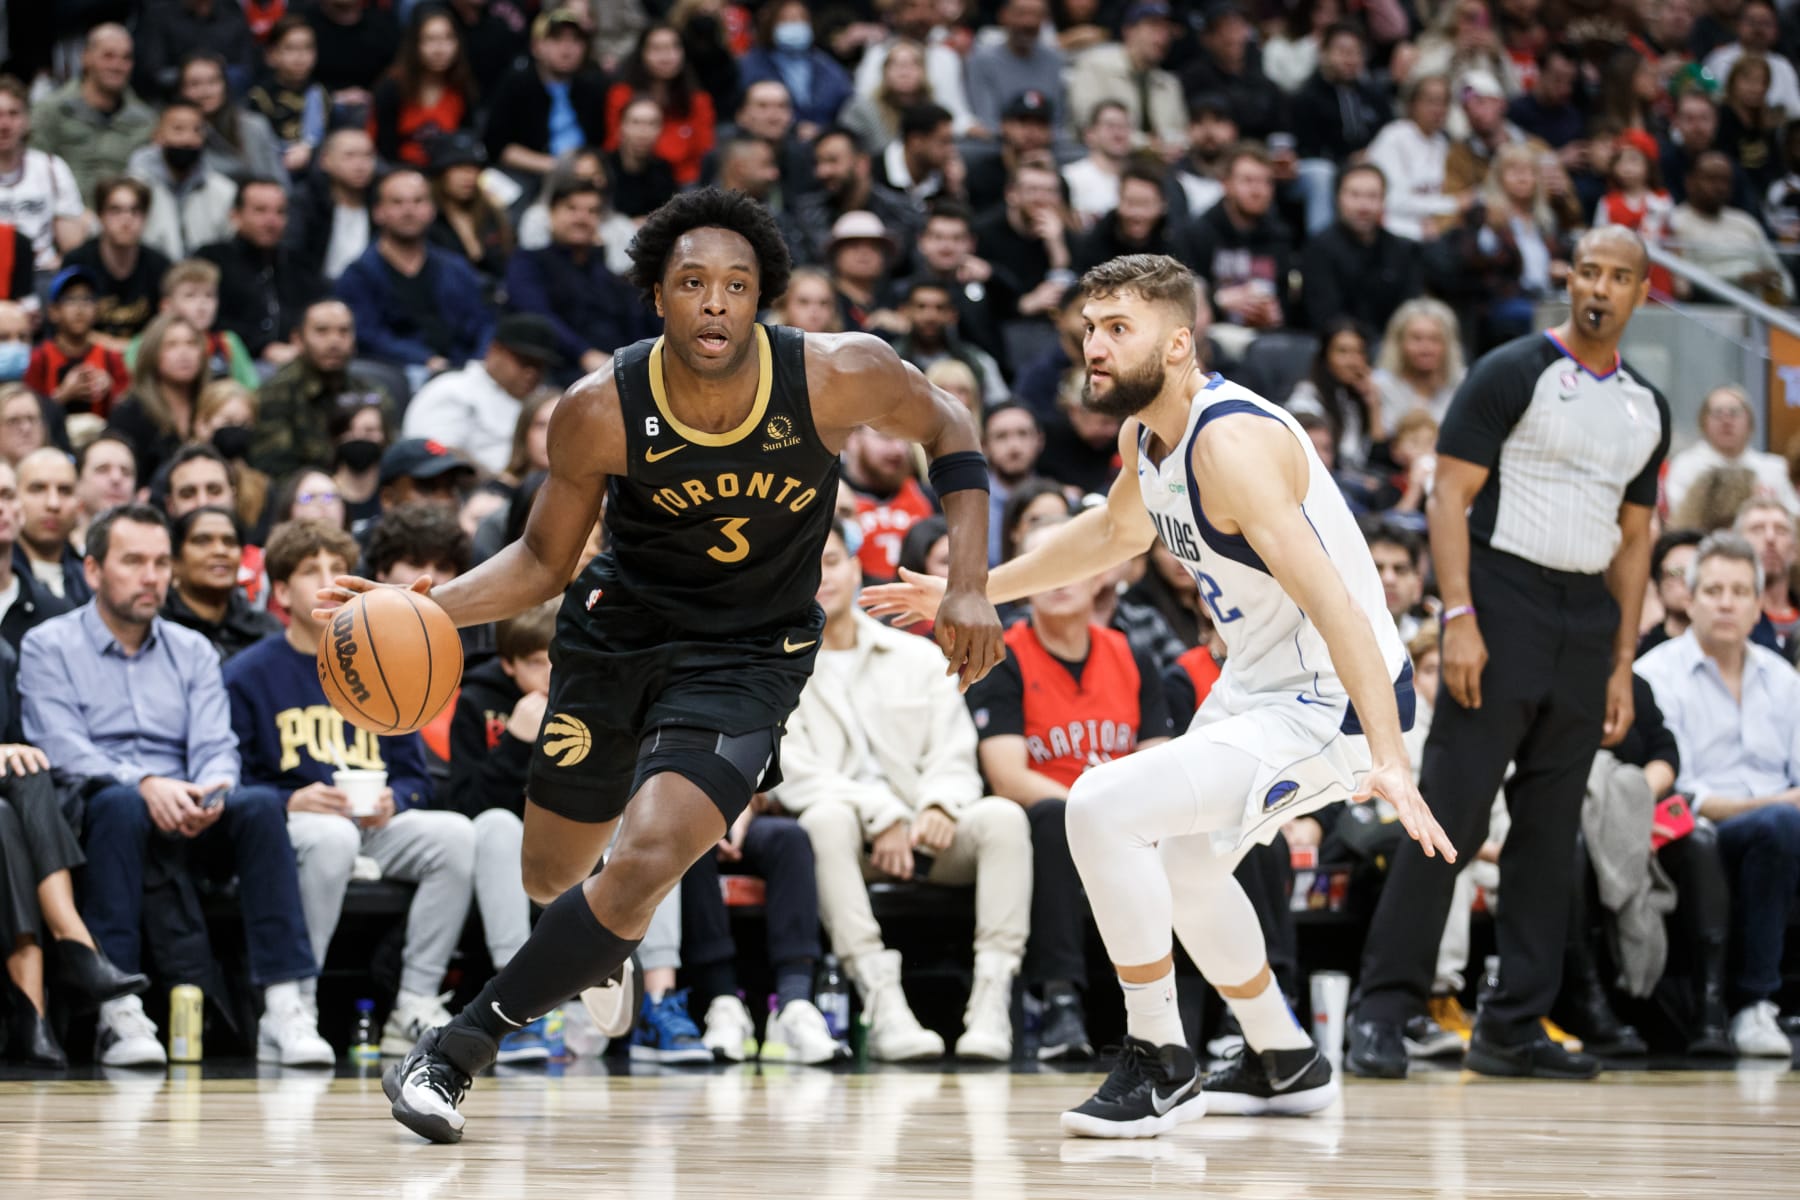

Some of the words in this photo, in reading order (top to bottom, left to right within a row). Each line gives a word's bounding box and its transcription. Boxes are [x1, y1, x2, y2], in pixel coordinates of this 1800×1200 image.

[645, 416, 660, 436] 6
[762, 442, 782, 452] Sun
[783, 435, 801, 447] Life
[652, 472, 817, 516] TORONTO
[706, 516, 750, 563] 3
[1185, 563, 1245, 624] 2
[333, 608, 371, 703] Wilson
